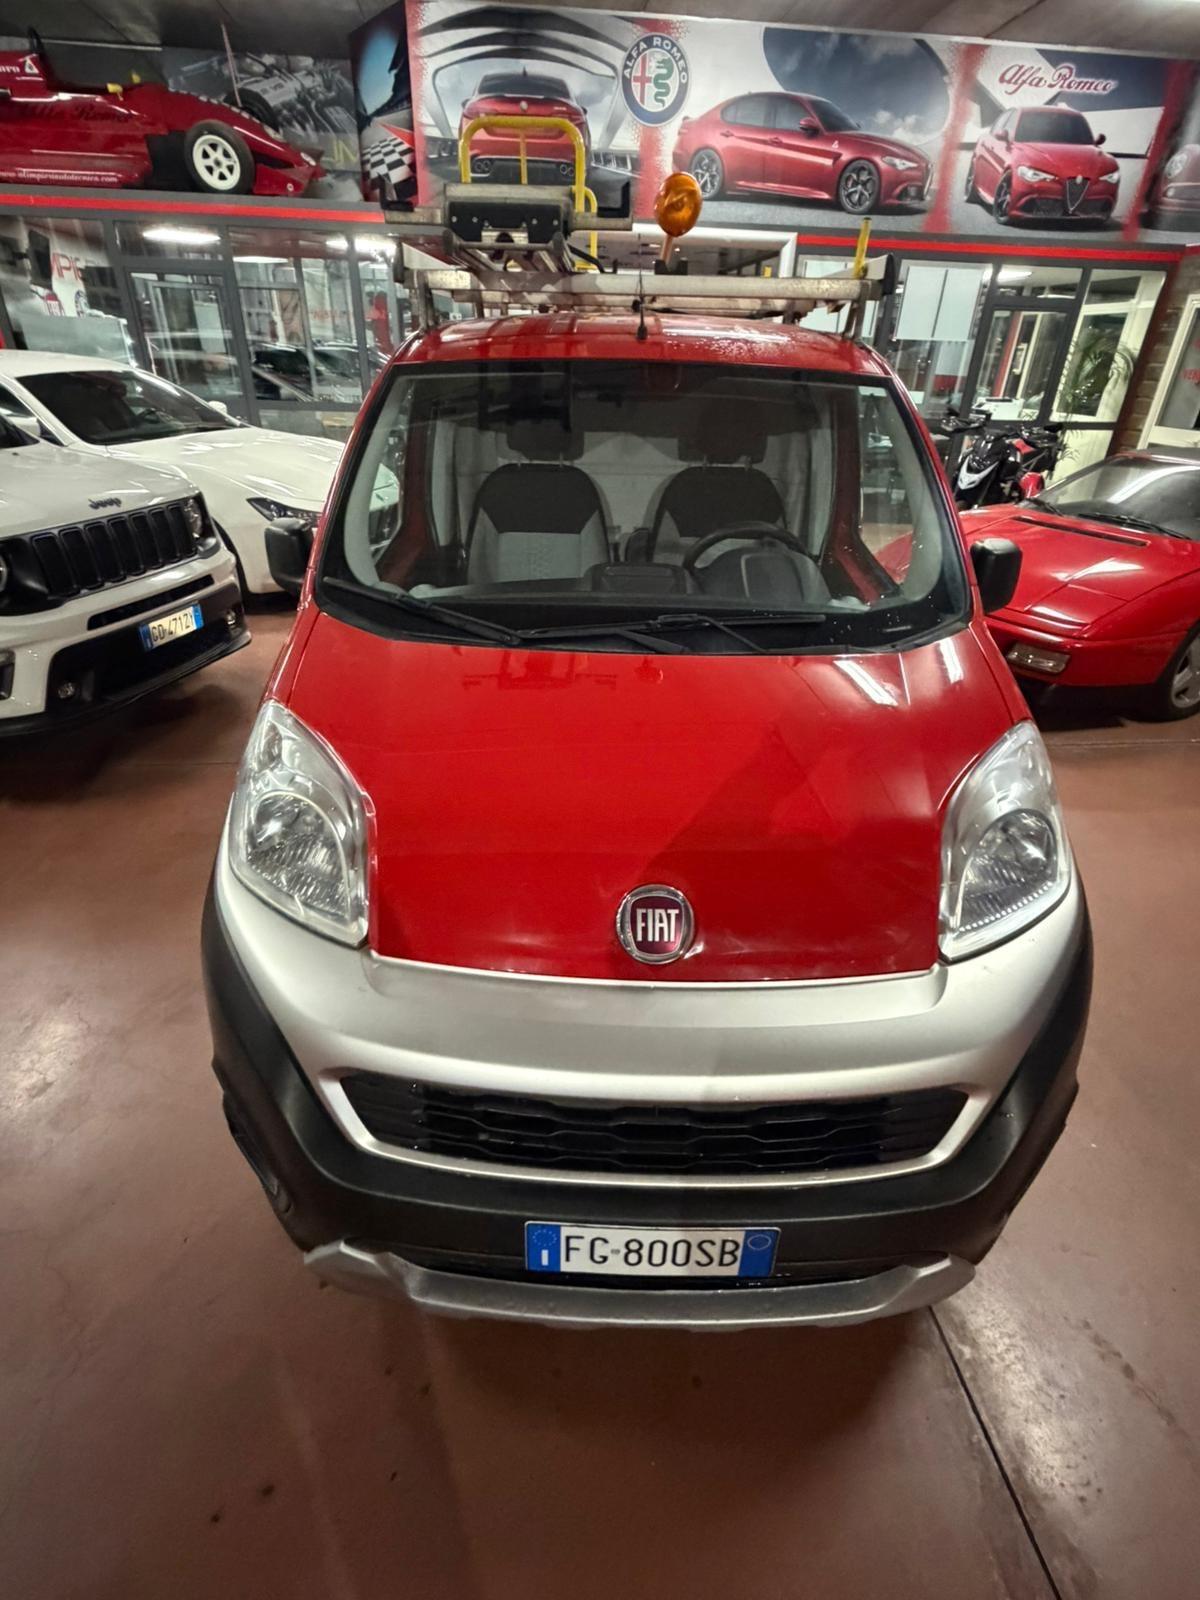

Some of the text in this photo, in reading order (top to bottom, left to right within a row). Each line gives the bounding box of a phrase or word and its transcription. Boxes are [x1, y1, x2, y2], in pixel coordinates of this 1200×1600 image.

[624, 37, 688, 83] ALFA ROMEO
[998, 63, 1117, 95] Alfa Romeo
[636, 908, 679, 942] FIAT
